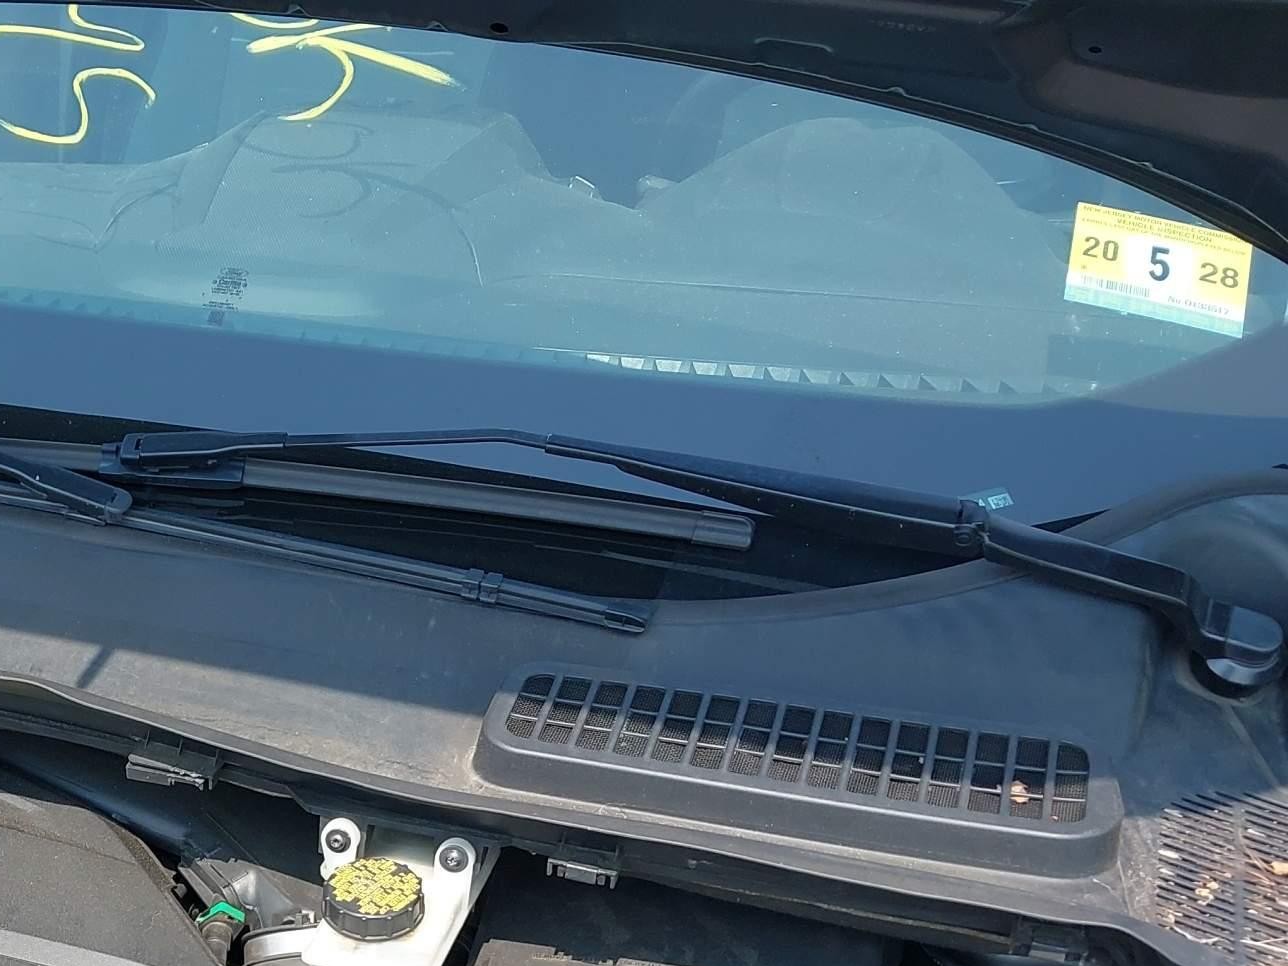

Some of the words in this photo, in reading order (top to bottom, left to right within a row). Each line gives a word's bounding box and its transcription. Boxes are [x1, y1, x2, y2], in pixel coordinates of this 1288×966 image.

[1082, 236, 1120, 262] 20
[1148, 245, 1171, 282] 5
[1199, 262, 1240, 289] 28
